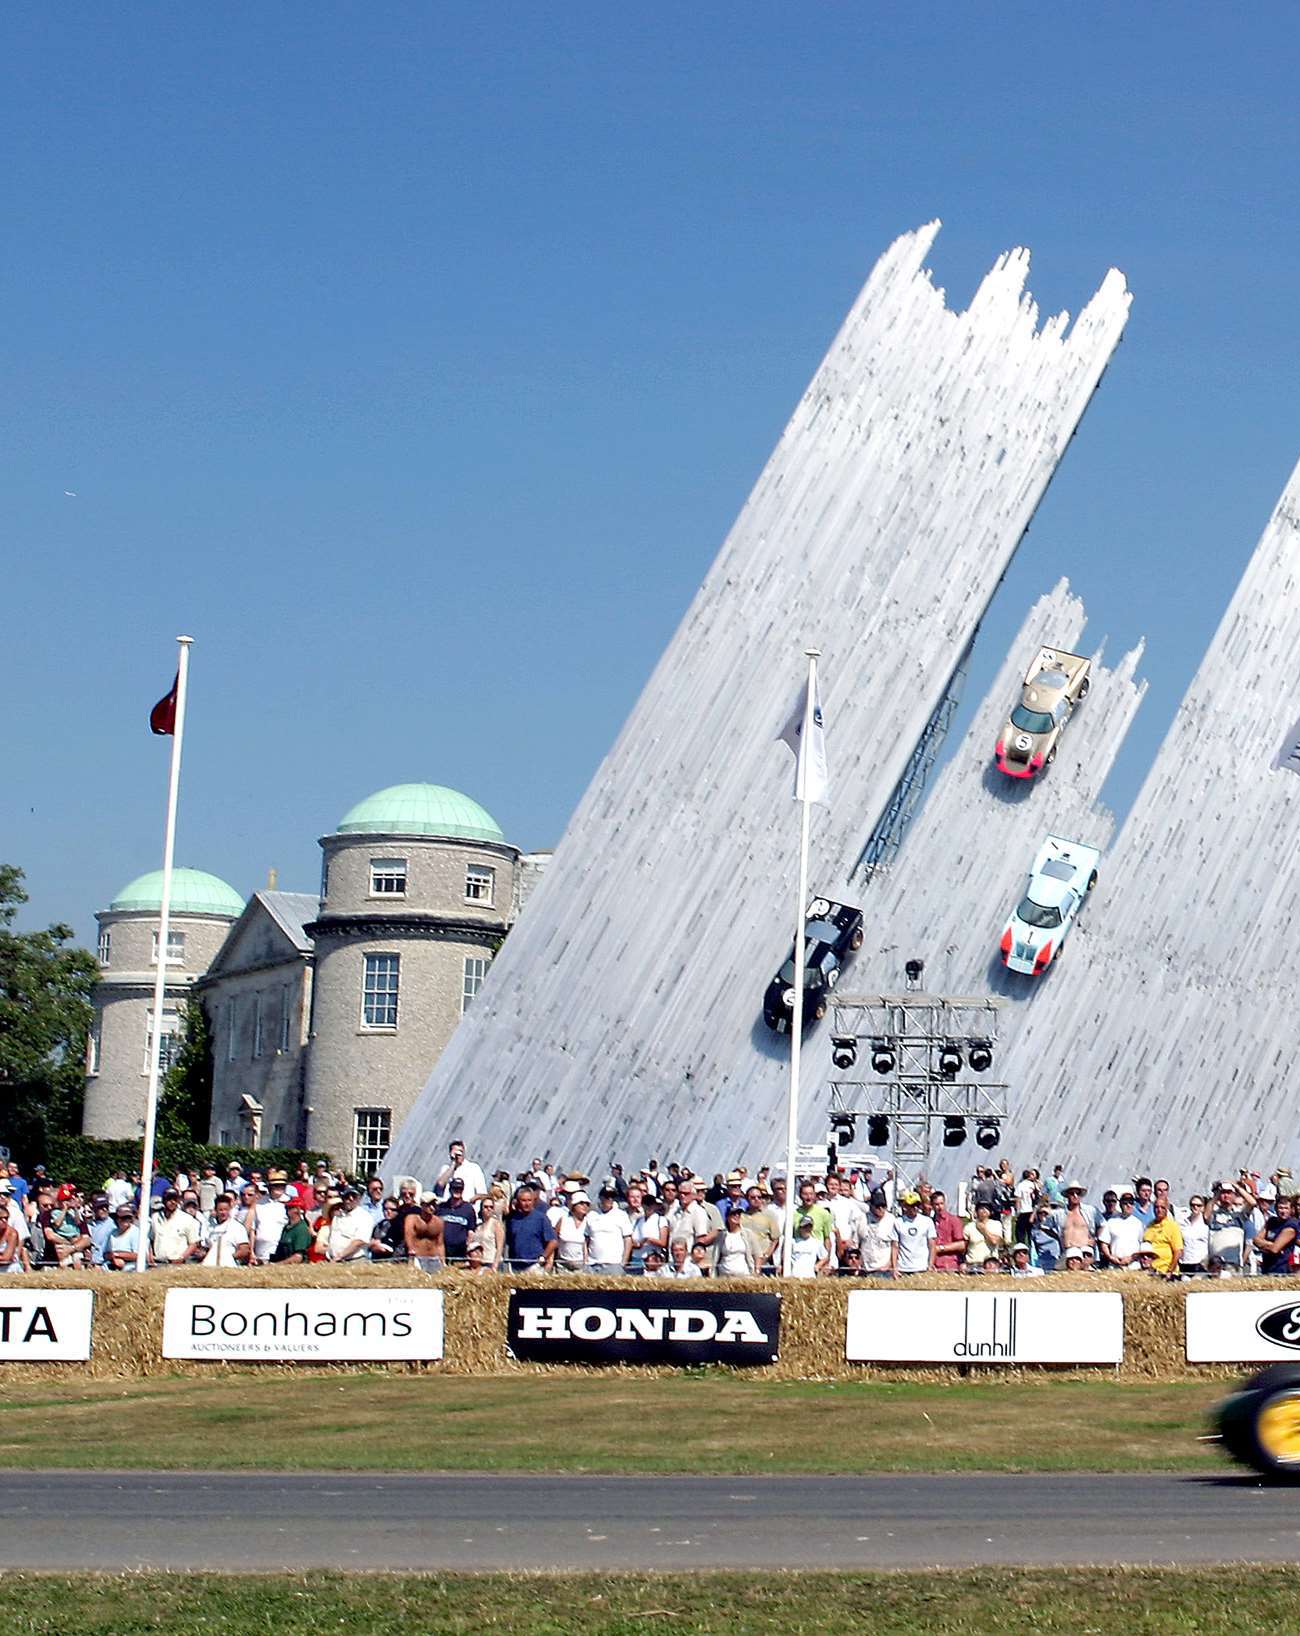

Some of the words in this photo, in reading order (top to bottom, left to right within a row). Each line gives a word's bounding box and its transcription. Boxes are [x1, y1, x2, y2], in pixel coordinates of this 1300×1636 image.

[190, 1302, 412, 1337] Bonhams
[517, 1306, 769, 1343] HONDA
[953, 1297, 1017, 1357] dunhill
